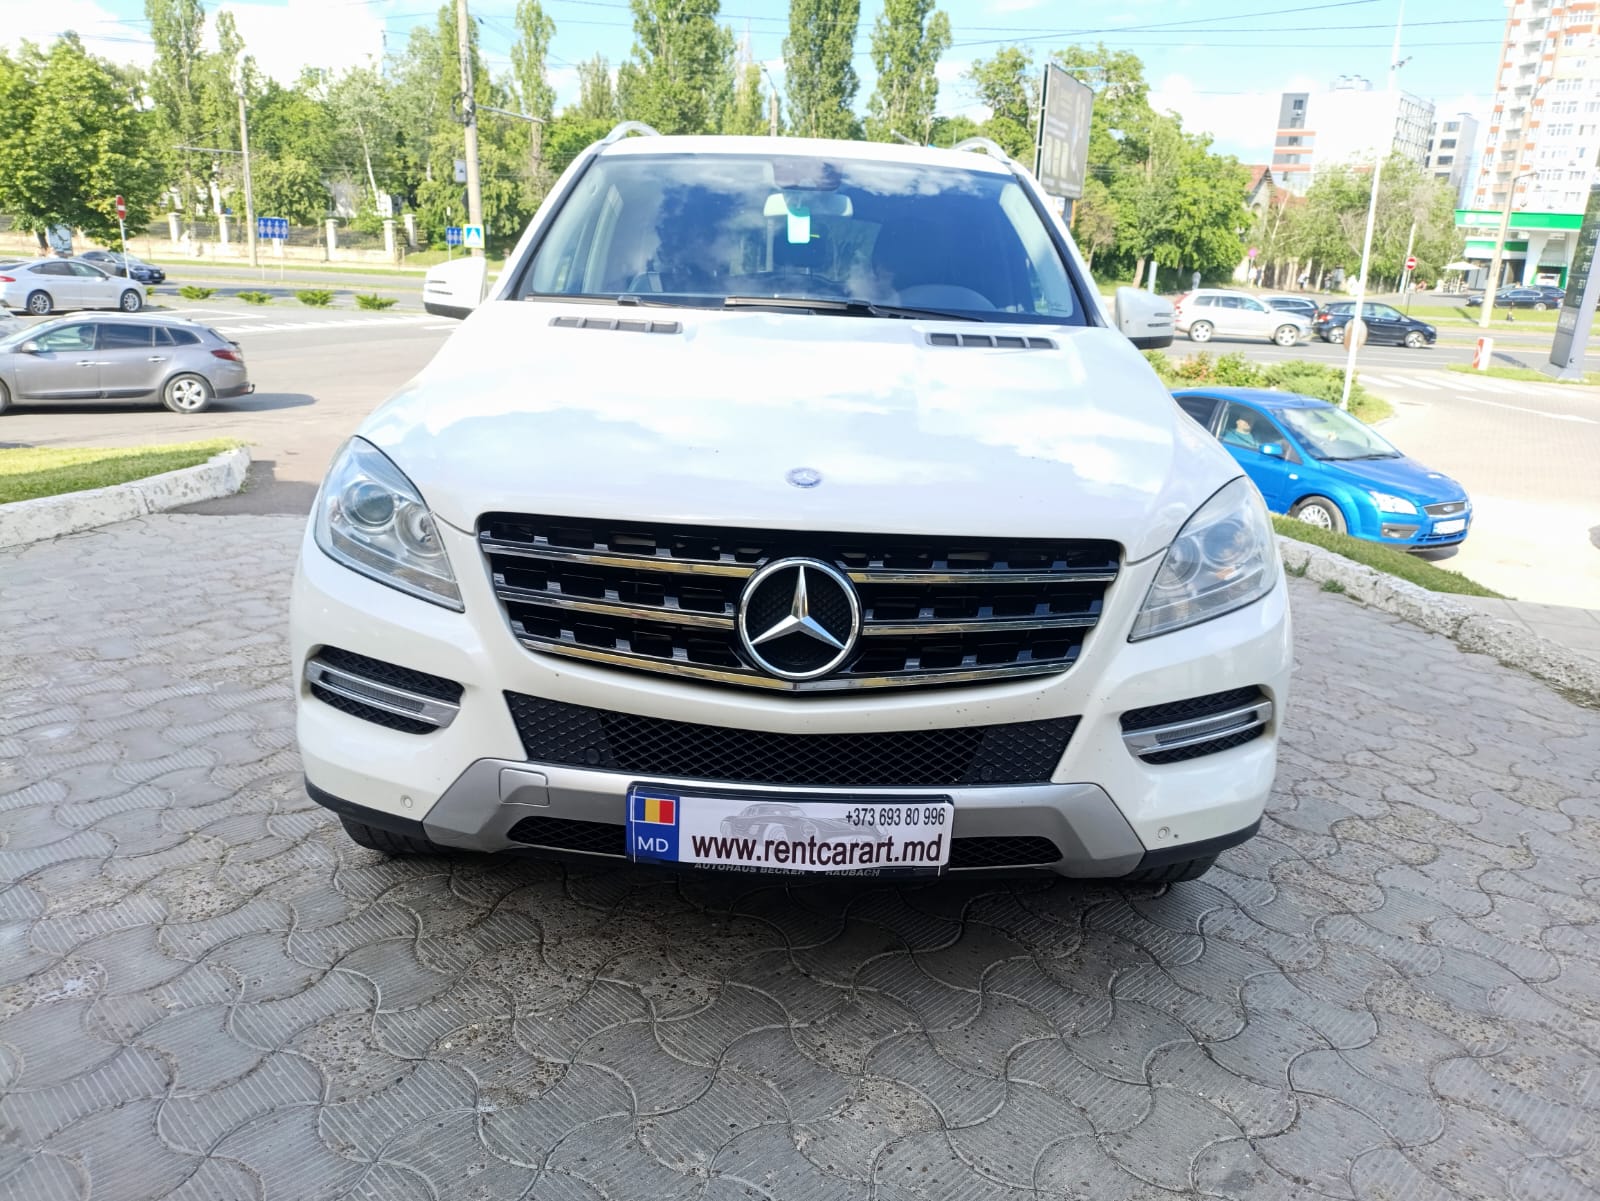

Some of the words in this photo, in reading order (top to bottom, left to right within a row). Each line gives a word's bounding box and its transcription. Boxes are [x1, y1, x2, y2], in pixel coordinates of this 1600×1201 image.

[846, 807, 875, 826] +373
[879, 808, 902, 826] 693
[905, 808, 920, 826] 80
[923, 808, 945, 825] 996
[637, 836, 669, 852] MD
[691, 833, 943, 866] www.rentcarart.md
[694, 863, 756, 873] AUTOHAUS
